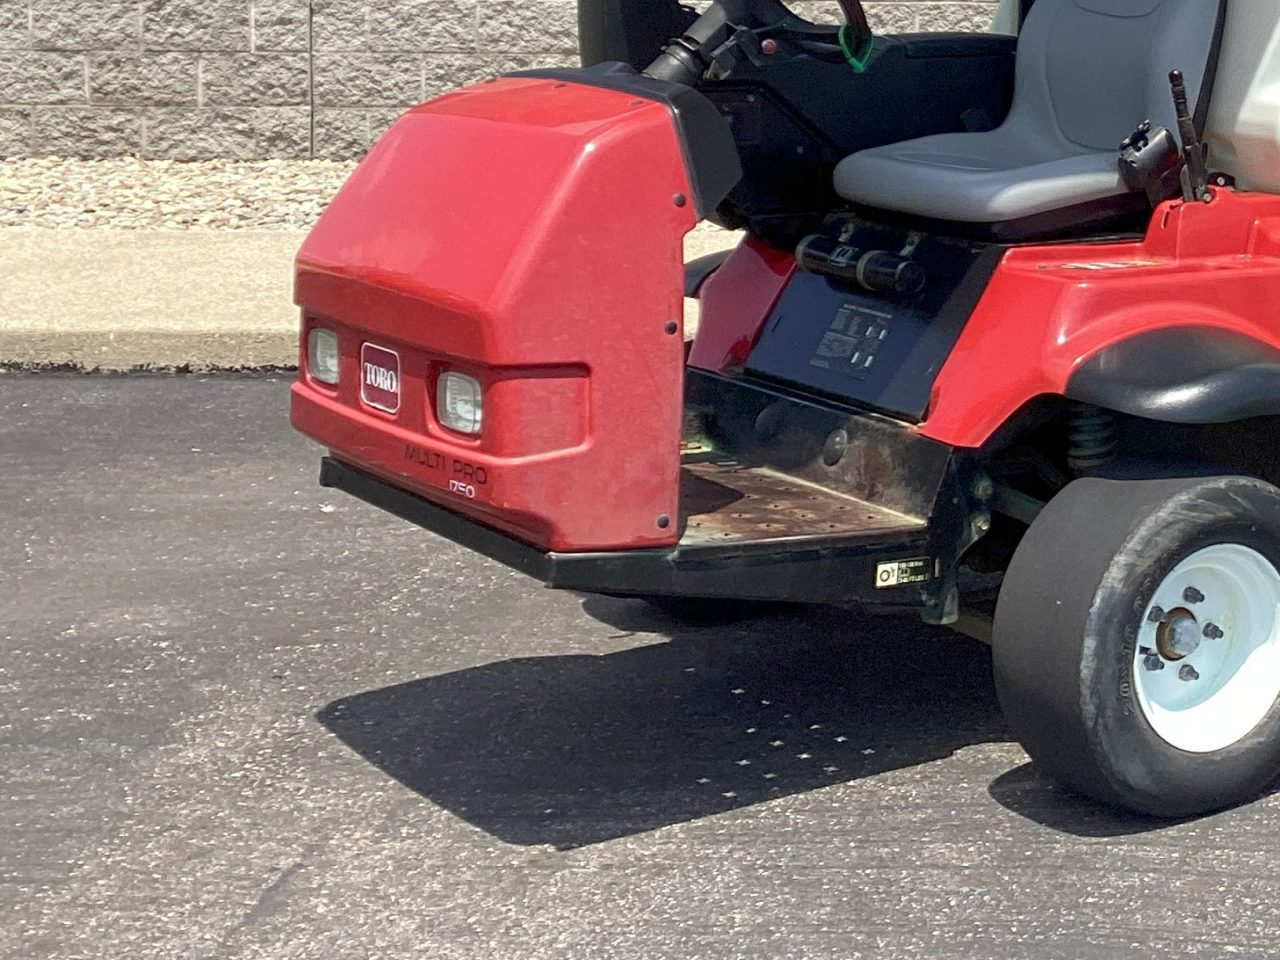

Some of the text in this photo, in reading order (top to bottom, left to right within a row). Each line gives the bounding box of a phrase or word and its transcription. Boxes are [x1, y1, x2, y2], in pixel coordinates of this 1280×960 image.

[364, 362, 397, 392] TORO
[404, 445, 488, 484] MULTI PRO
[448, 479, 475, 498] 1750
